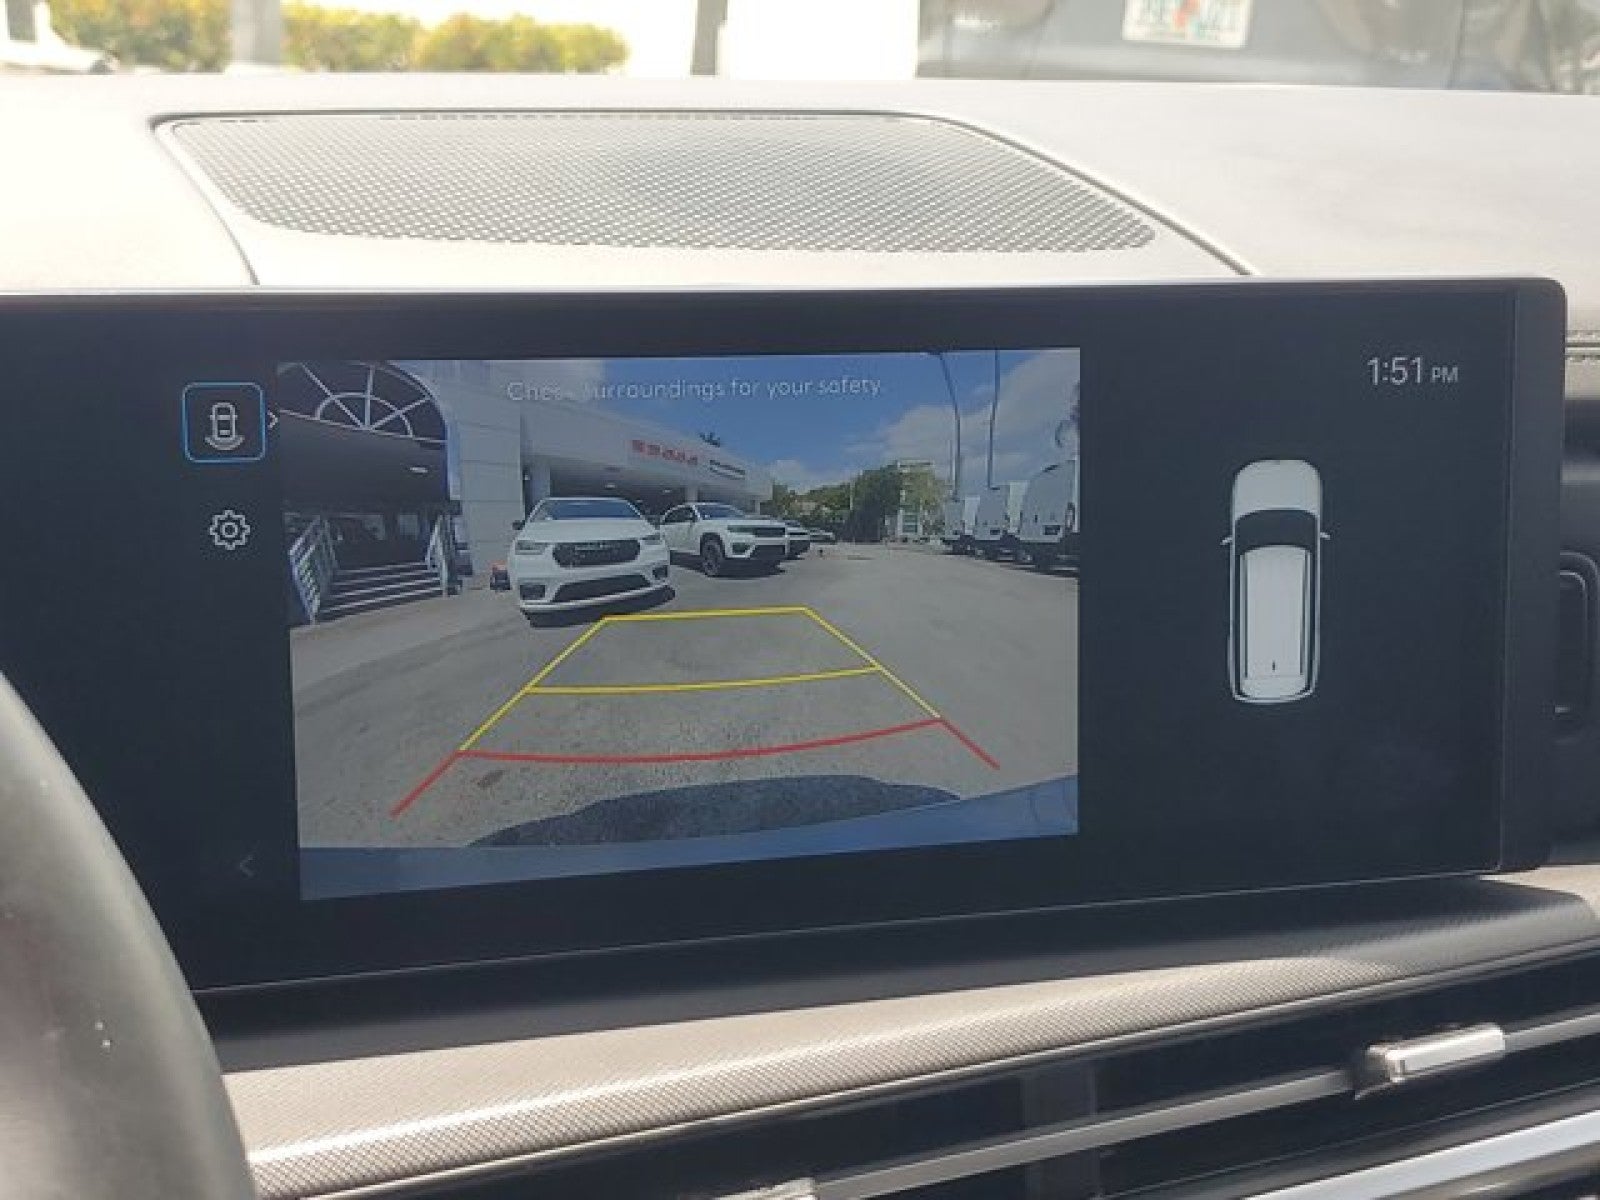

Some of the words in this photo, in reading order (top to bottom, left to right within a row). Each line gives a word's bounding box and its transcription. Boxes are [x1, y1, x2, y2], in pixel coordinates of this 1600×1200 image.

[1367, 356, 1421, 385] 1:51
[1431, 366, 1458, 383] PM
[731, 378, 760, 397] for
[767, 381, 813, 400] your
[818, 375, 881, 399] safety
